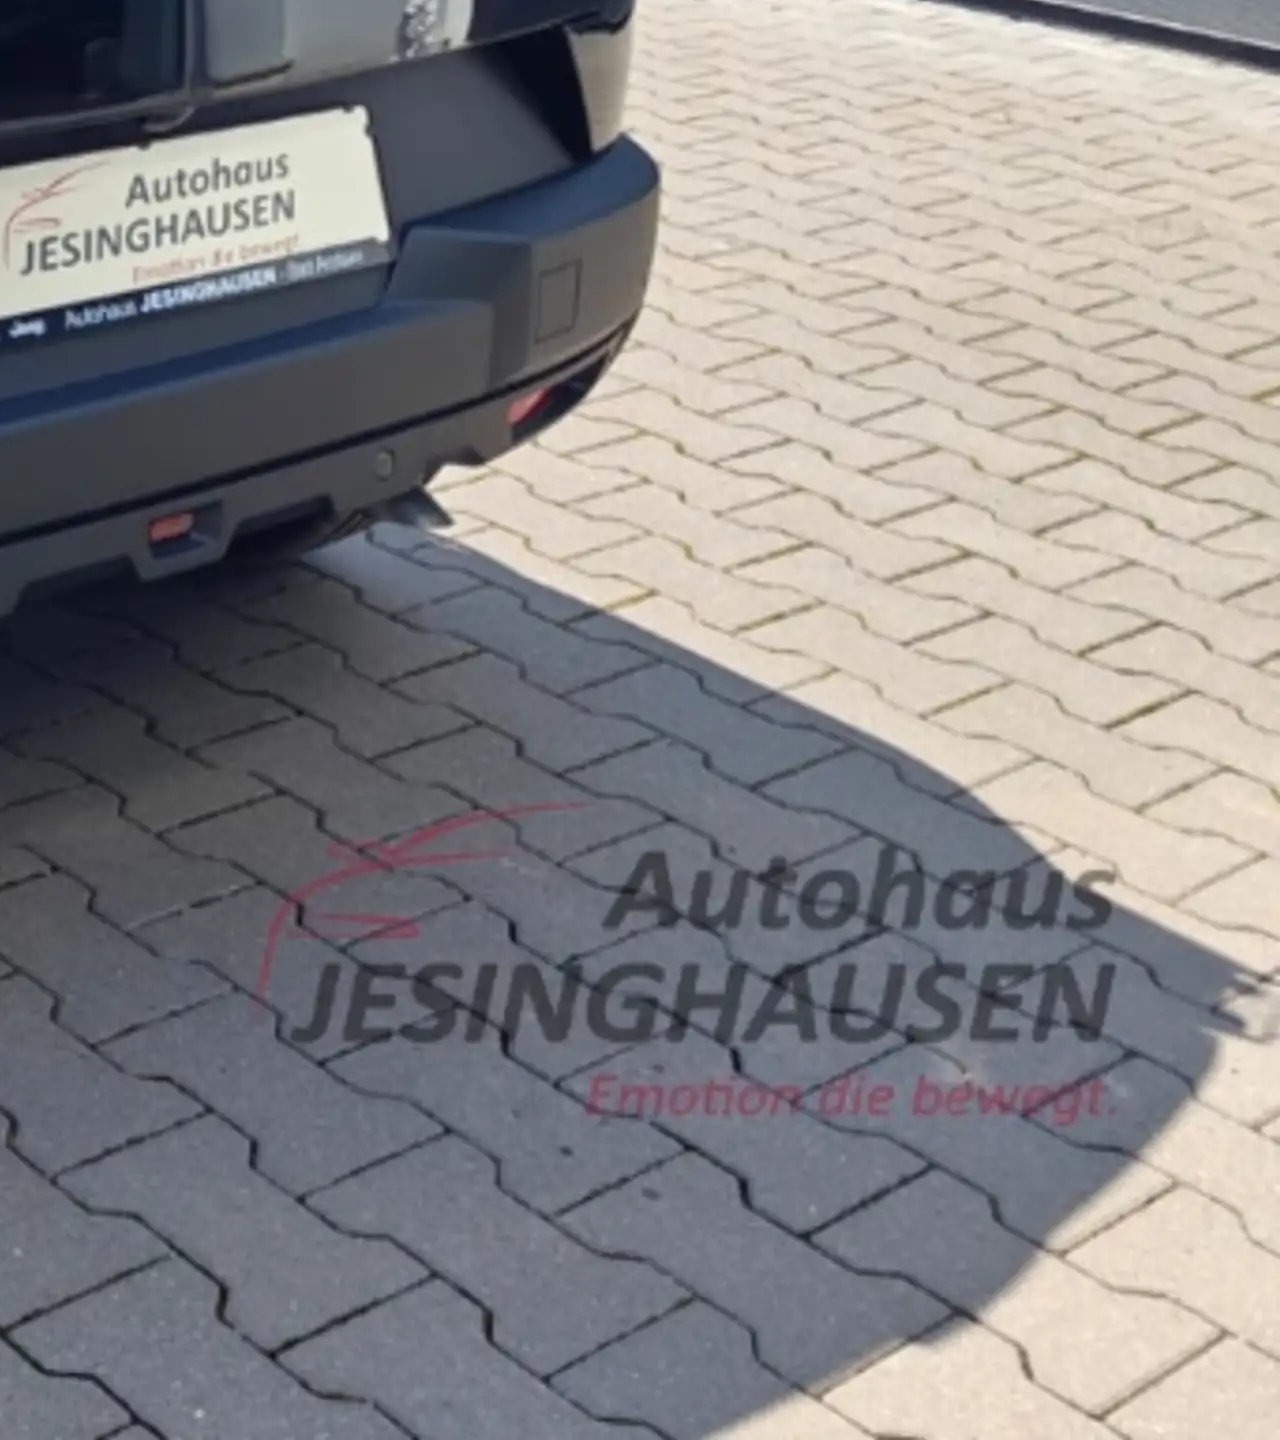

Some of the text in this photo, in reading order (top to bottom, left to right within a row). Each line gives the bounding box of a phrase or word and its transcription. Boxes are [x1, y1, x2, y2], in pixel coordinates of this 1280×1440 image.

[124, 153, 290, 208] Autohaus
[19, 188, 297, 276] JESINGHAUSEN
[141, 266, 278, 312] JESINGHAUSEN
